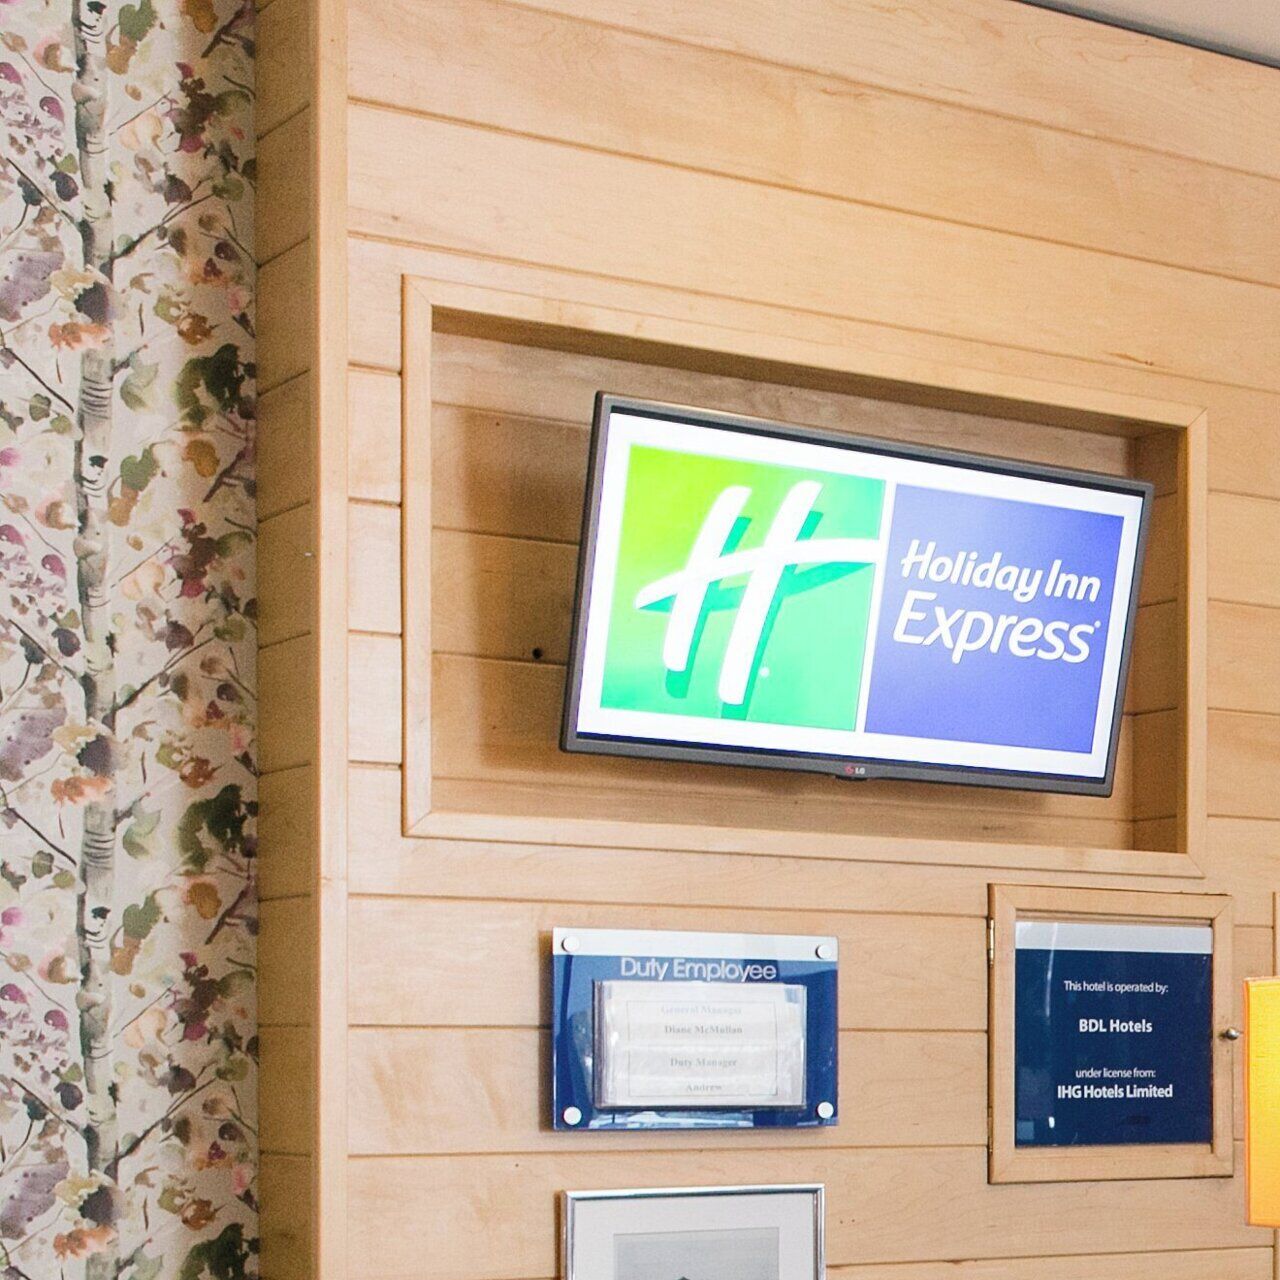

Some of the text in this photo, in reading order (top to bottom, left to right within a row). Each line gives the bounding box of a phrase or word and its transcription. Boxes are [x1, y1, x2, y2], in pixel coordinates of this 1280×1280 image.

[901, 539, 1102, 603] Holiday Inn
[893, 591, 1095, 663] Express
[621, 958, 777, 982] Duty Employee
[1064, 980, 1169, 994] This hotel is operated by:
[1079, 1018, 1152, 1032] BDL Hotels
[670, 1058, 692, 1068] Duty
[1076, 1068, 1156, 1078] under license from:
[1058, 1084, 1173, 1099] IHG Hotels Limited
